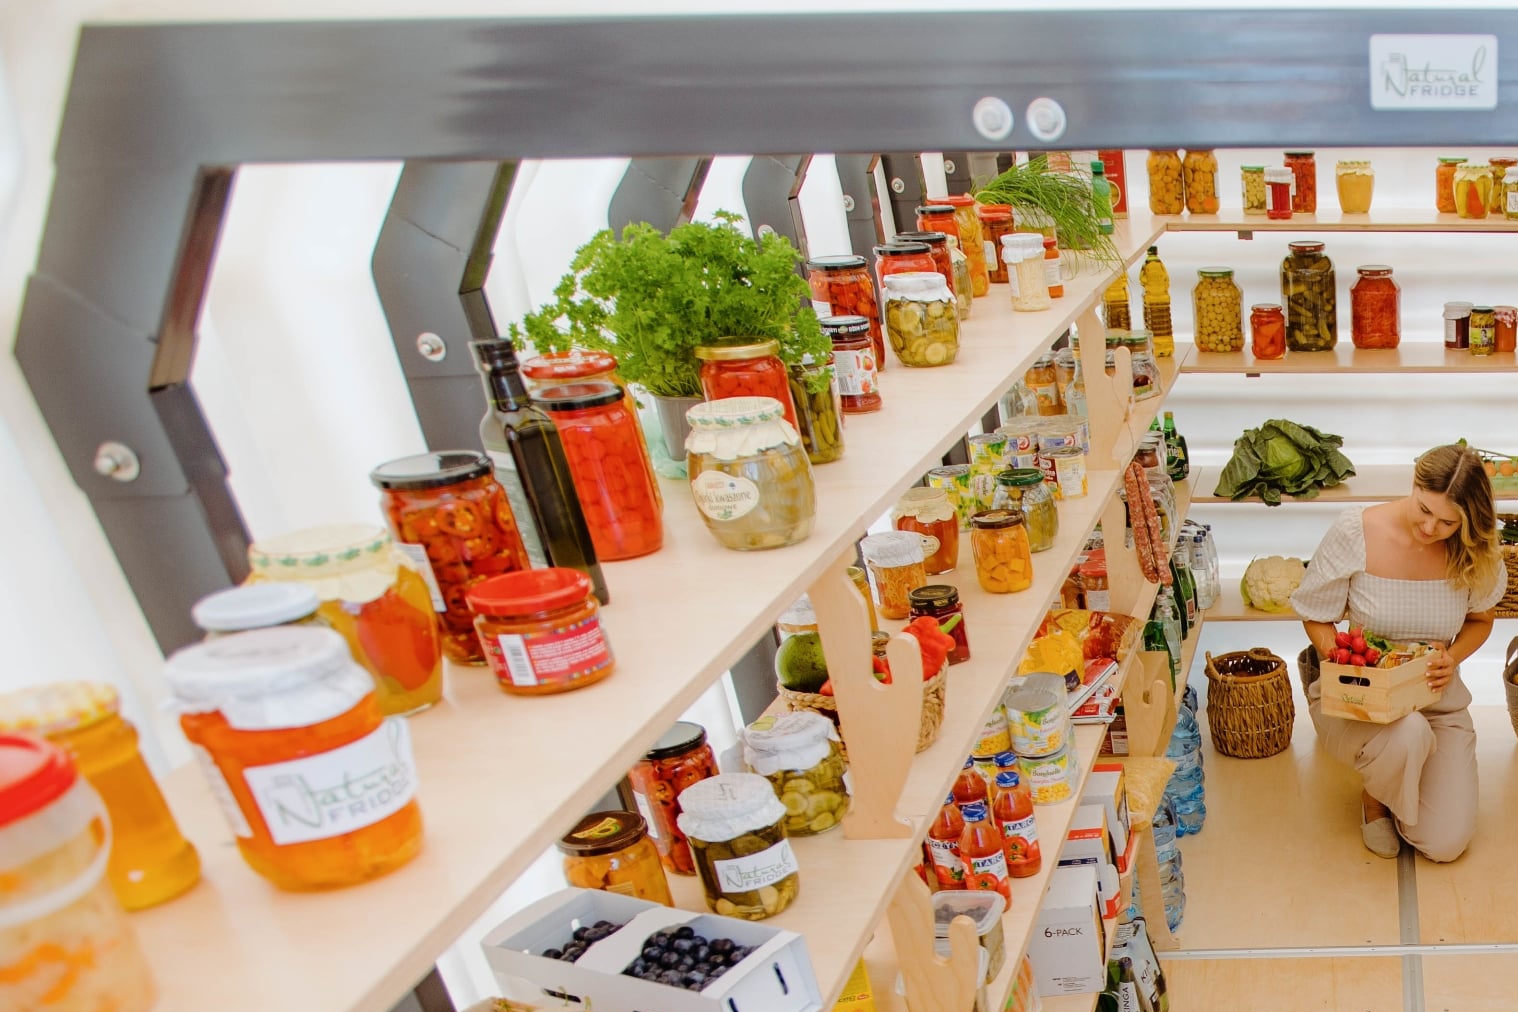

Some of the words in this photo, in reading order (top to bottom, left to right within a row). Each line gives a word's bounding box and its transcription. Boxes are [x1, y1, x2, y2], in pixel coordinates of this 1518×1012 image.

[1385, 45, 1486, 97] Natural
[1409, 84, 1480, 96] FRIDGE
[1007, 817, 1035, 832] TARC
[973, 852, 1004, 868] TARC
[1044, 927, 1084, 938] 6-PACK
